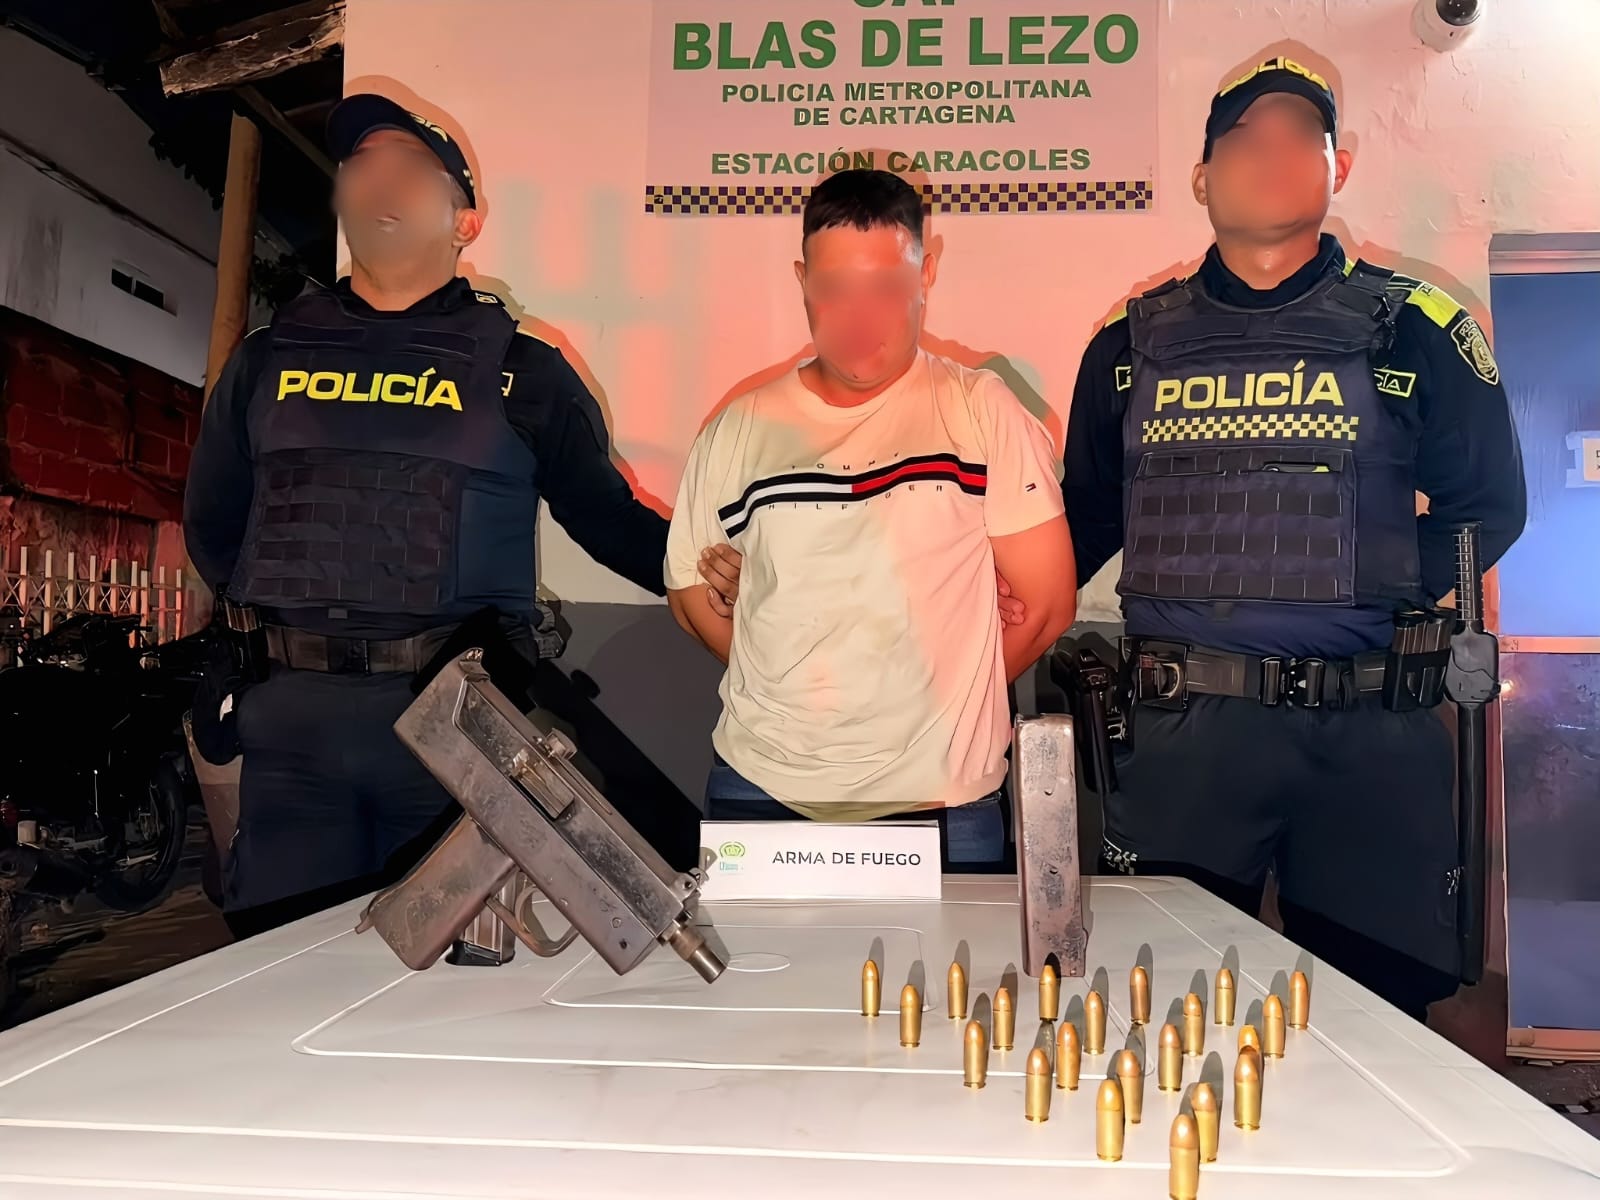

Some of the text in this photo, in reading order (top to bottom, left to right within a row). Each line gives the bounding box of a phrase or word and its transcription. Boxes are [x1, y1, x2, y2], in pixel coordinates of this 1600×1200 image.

[673, 14, 1139, 70] BLAS DE LEZO
[722, 80, 1092, 103] POLICIA METROPOLITANA
[794, 105, 1016, 126] DE CARTAGENA
[711, 147, 1091, 174] ESTACIÓN CARACOLES
[277, 368, 463, 411] POLICÍA
[1155, 360, 1345, 411] POLICÍA
[772, 851, 921, 866] ARMA DE FUEGO
